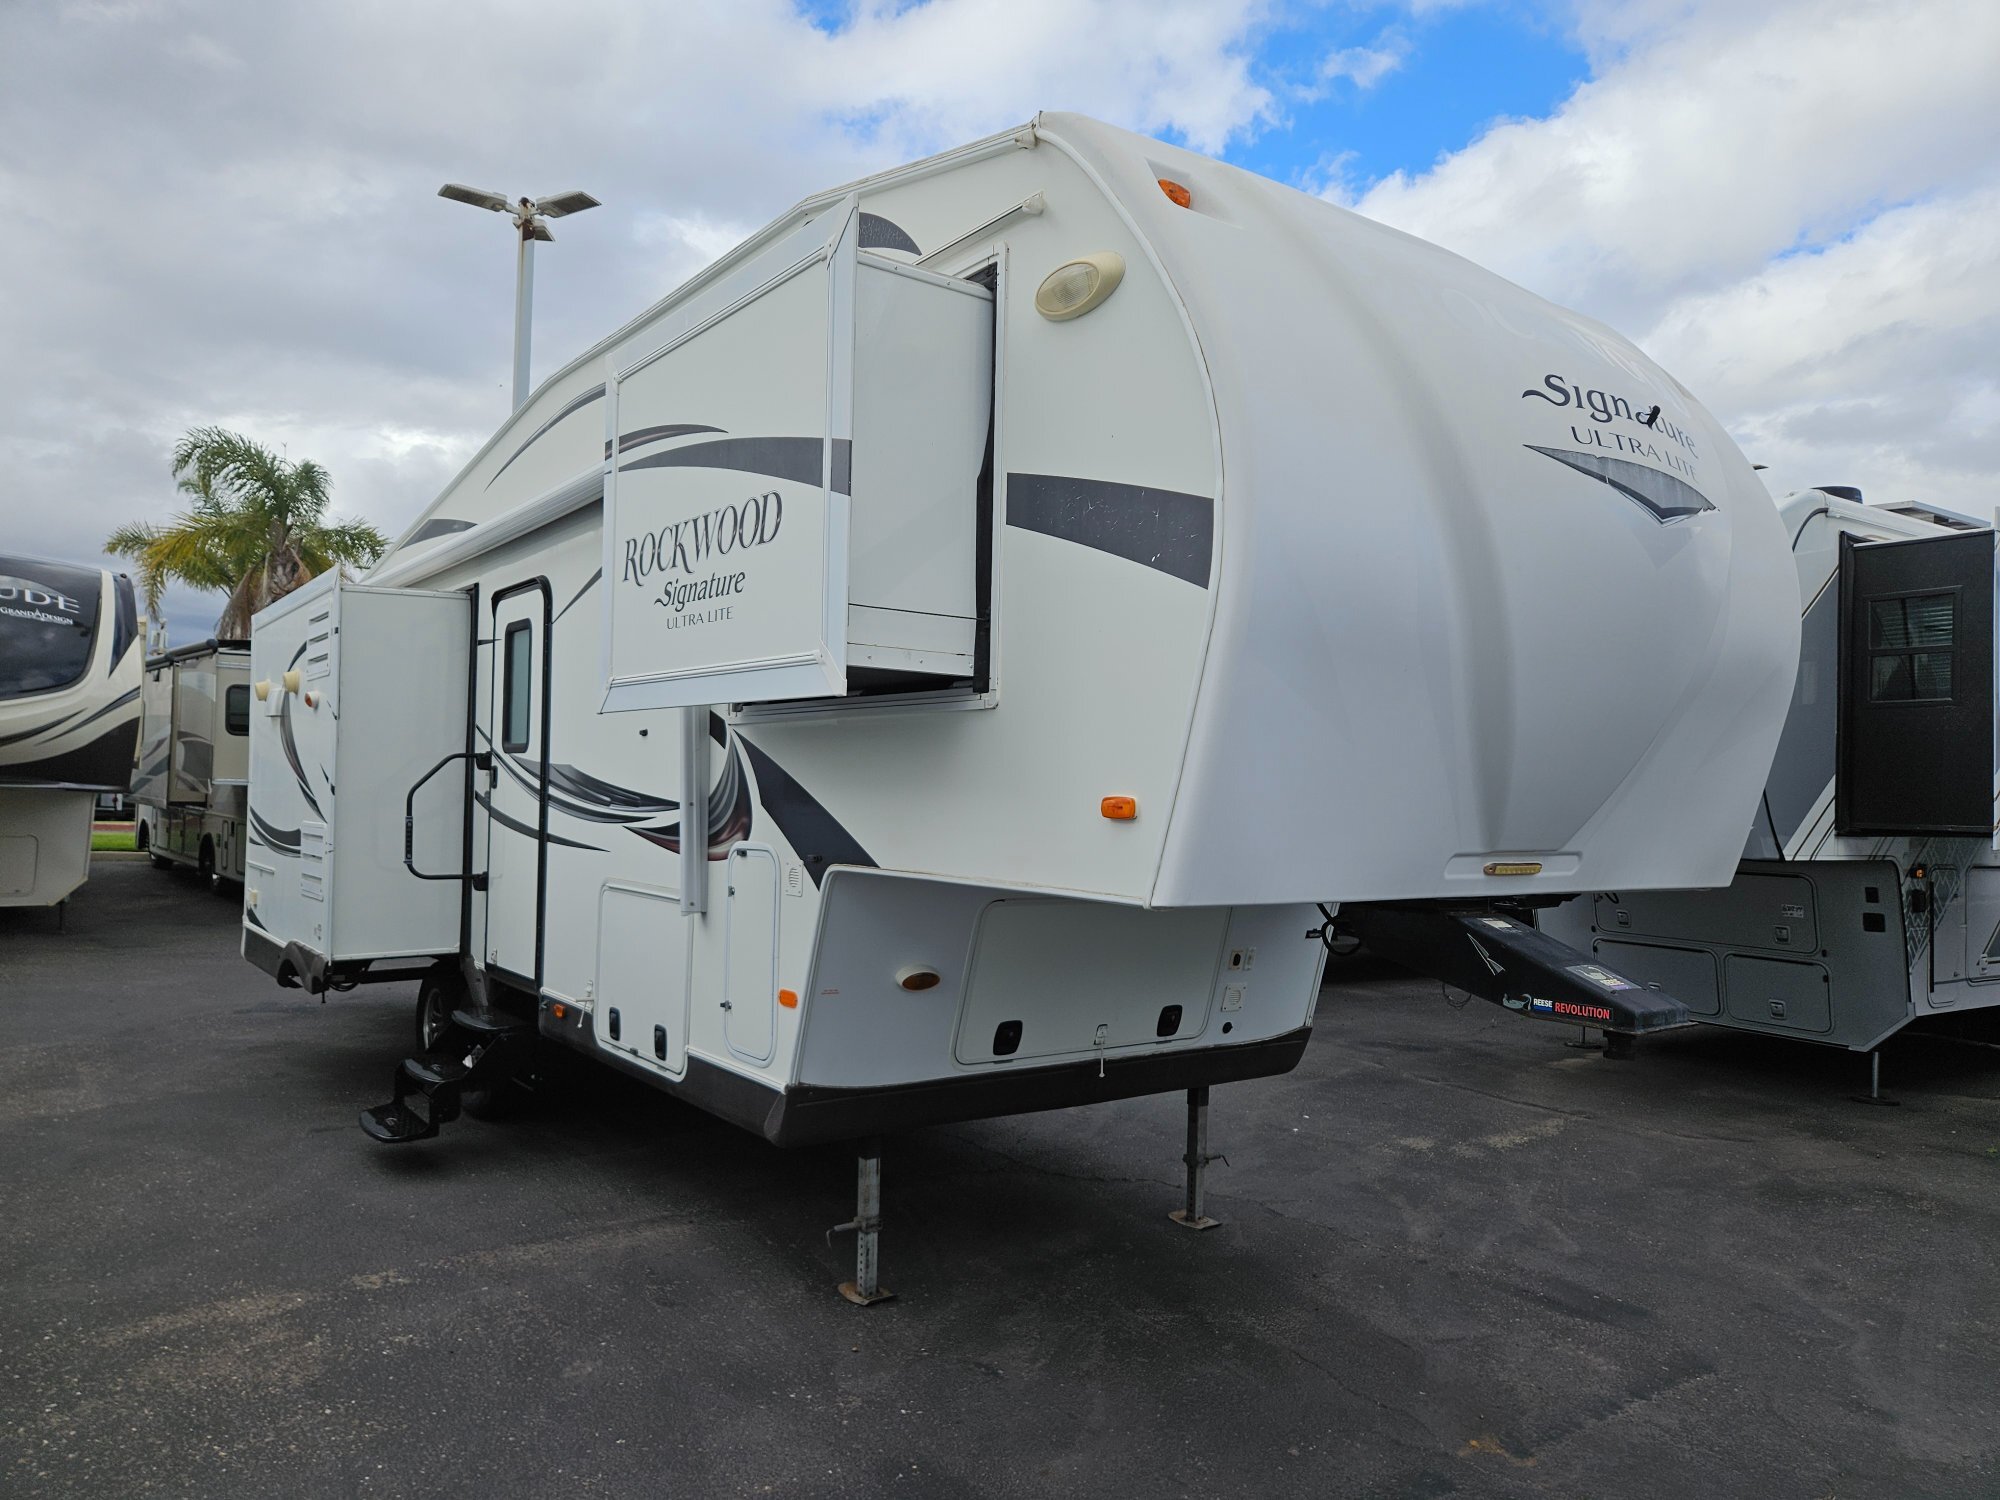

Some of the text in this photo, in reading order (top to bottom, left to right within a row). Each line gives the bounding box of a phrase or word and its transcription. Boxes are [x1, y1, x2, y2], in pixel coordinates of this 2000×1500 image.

[1571, 426, 1661, 462] ULTRA
[622, 491, 783, 586] ROCKWOOD
[654, 571, 746, 612] Signature
[666, 606, 734, 629] ULTRA LITE
[1533, 998, 1610, 1020] REESE REVOLUTION
